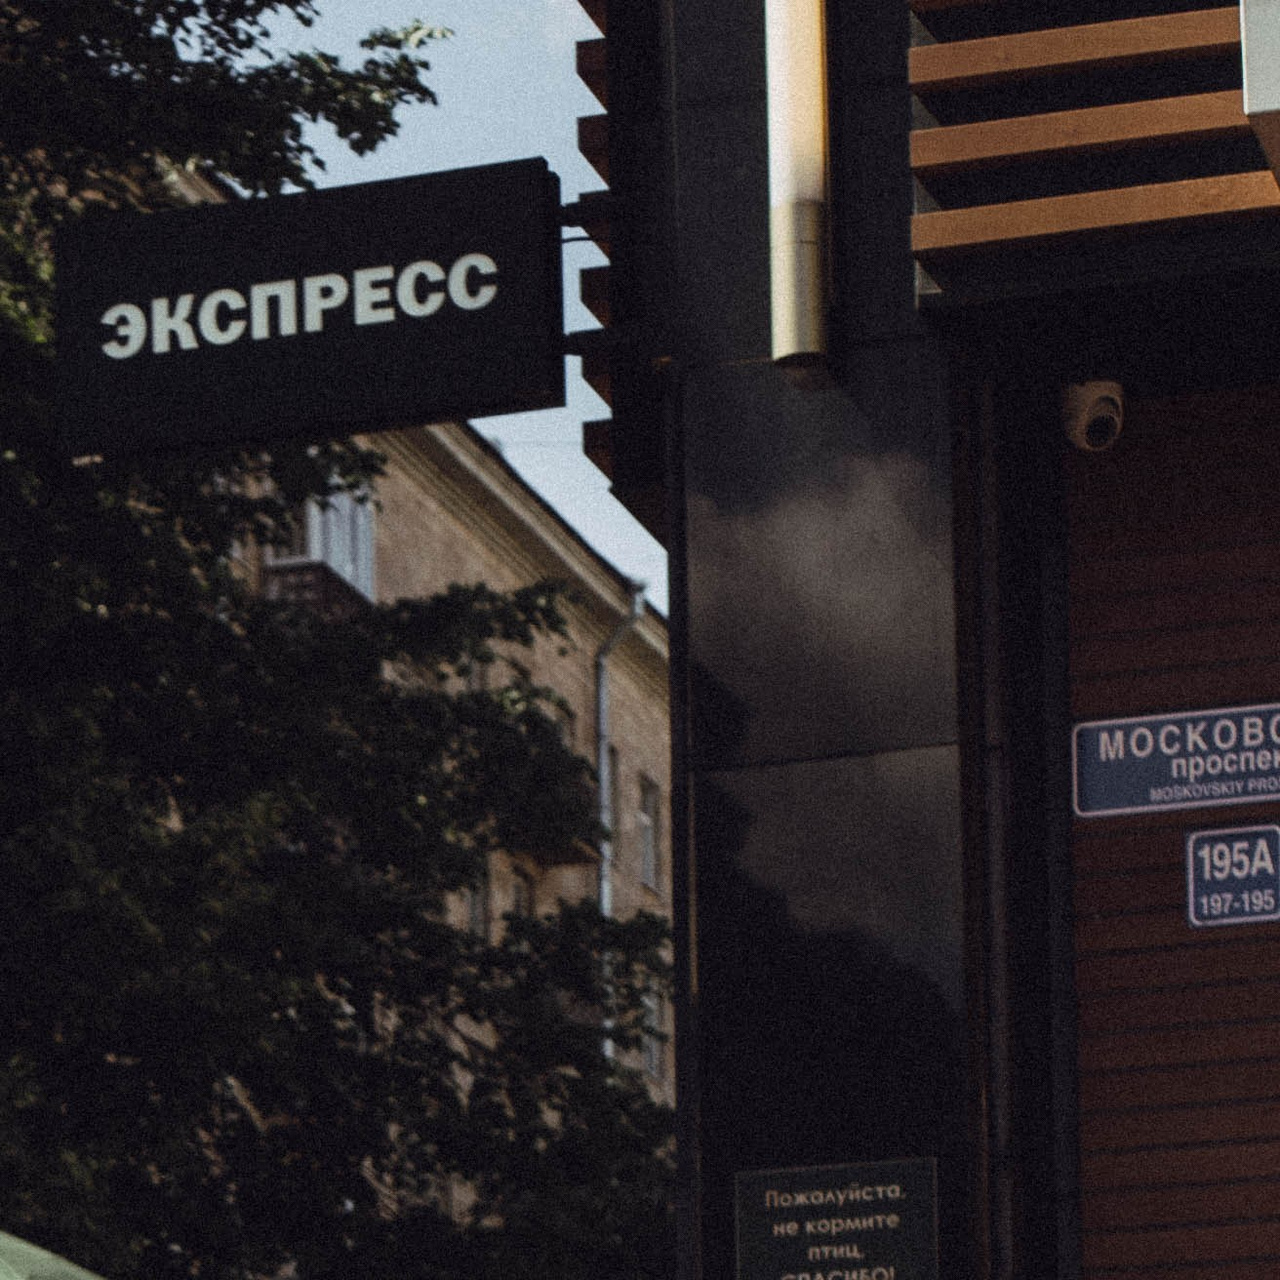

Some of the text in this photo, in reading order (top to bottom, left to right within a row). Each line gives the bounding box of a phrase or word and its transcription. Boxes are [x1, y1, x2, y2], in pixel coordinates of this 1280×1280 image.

[100, 252, 498, 359] ЭКСПРЕСС
[1248, 776, 1280, 793] PRO
[1197, 838, 1275, 881] 195А
[1200, 888, 1276, 916] 197-195
[772, 1213, 900, 1236] не кормите
